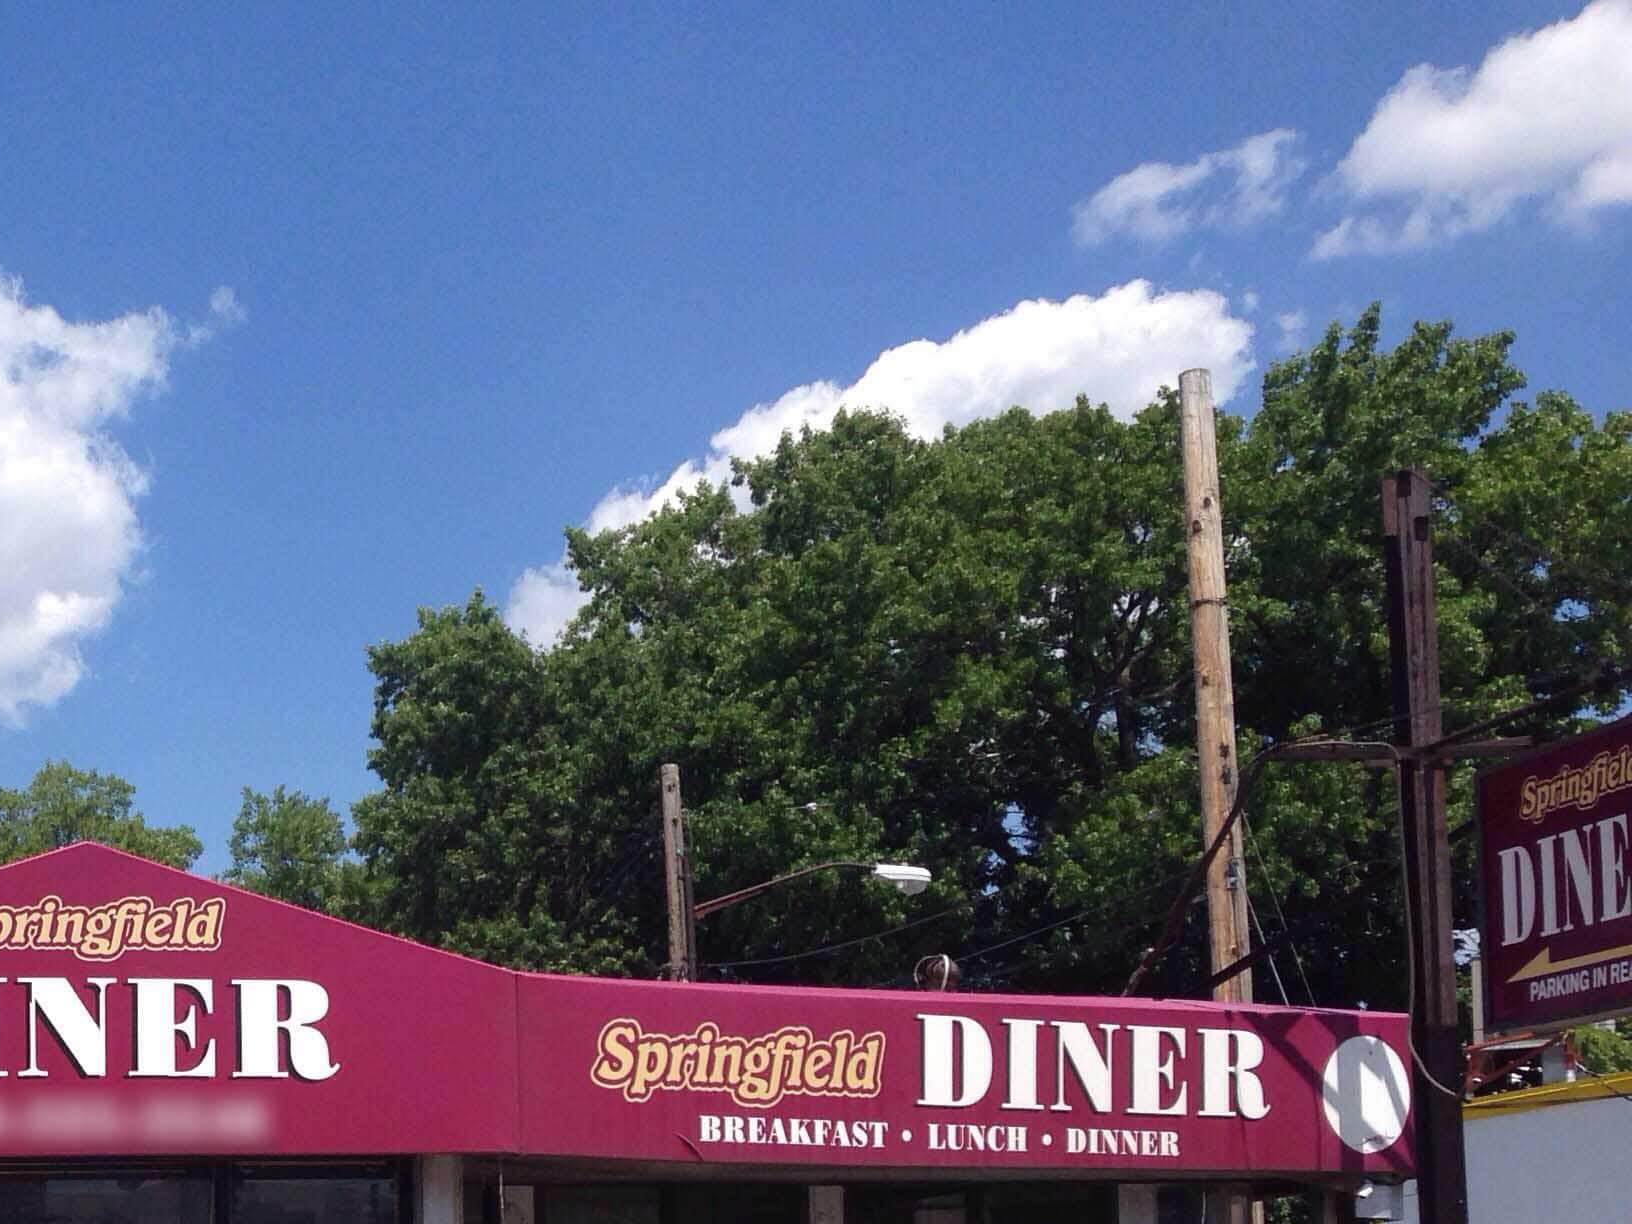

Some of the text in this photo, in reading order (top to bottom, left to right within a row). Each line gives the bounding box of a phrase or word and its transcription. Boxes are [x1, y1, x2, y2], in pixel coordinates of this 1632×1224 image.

[1529, 969, 1590, 1002] PARKING
[1593, 965, 1607, 989] IN
[593, 1013, 1272, 1120] Springfield DINER
[699, 1115, 1180, 1157] BREAKFAST LUNCH DINNER
